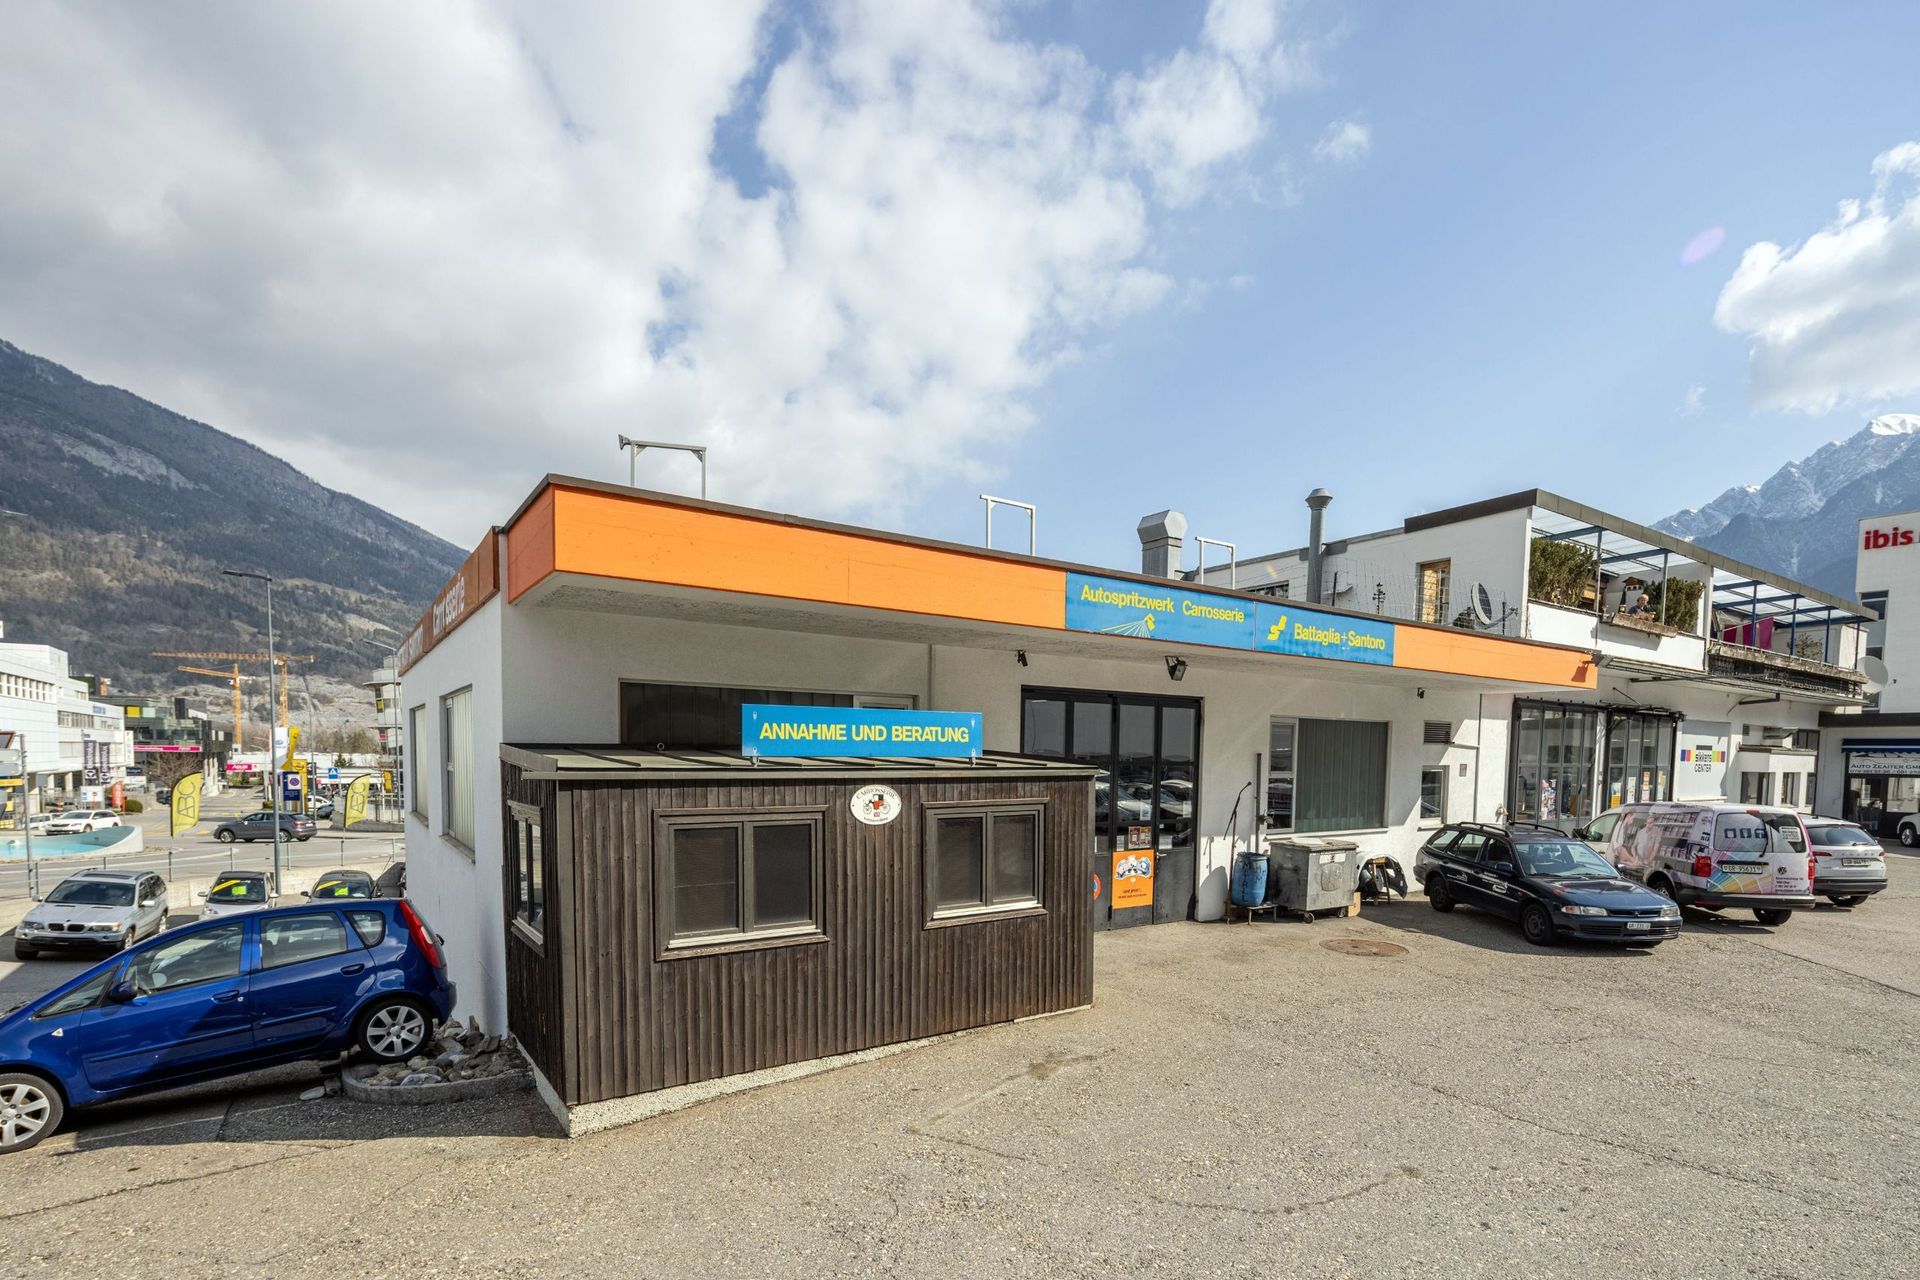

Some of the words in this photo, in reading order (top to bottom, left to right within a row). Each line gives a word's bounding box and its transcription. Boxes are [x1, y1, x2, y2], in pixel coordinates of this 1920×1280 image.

[1864, 527, 1914, 550] ibis
[1081, 584, 1175, 613] Autospritzwerk
[1182, 600, 1245, 623] Carrosserie
[759, 722, 847, 741] ANNAHME
[852, 725, 887, 742] UND
[891, 726, 969, 743] BERATUNG
[1694, 763, 1712, 773] CENTER
[177, 781, 196, 819] ABC
[350, 782, 366, 814] ABC
